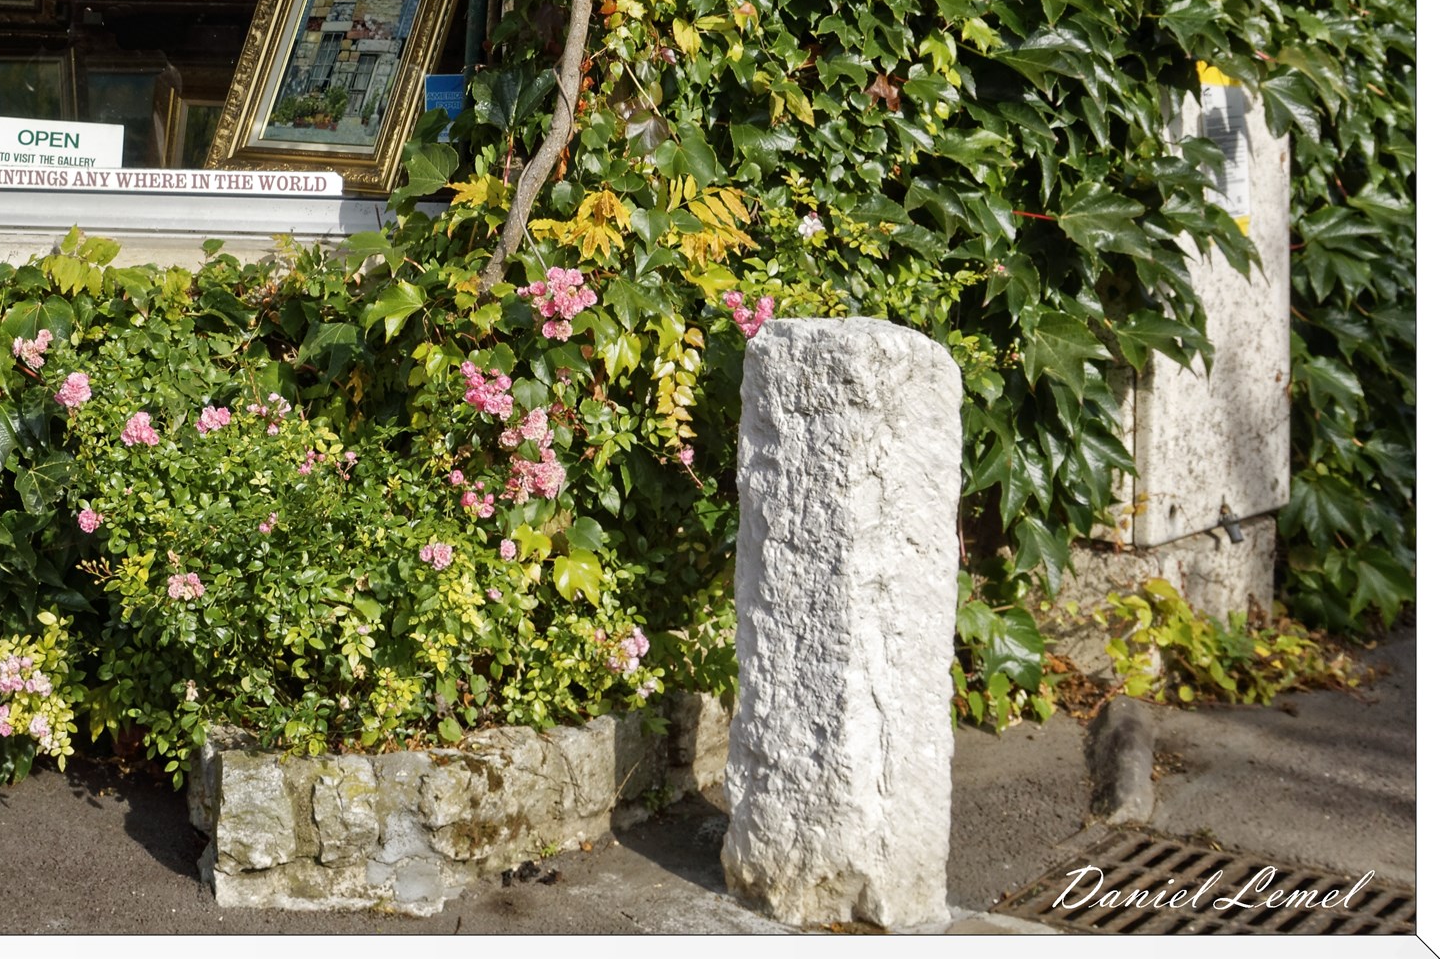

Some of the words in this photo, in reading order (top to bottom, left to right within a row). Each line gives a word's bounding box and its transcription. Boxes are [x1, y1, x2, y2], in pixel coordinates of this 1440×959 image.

[18, 130, 80, 148] OPEN
[0, 152, 10, 162] TO
[13, 153, 35, 163] VISIT
[39, 154, 55, 165] THE
[58, 156, 96, 167] GALLERY
[72, 171, 110, 188] ANY
[116, 172, 187, 189] WHERE
[191, 174, 211, 189] IN
[215, 174, 253, 190] THE
[258, 175, 328, 192] WORLD
